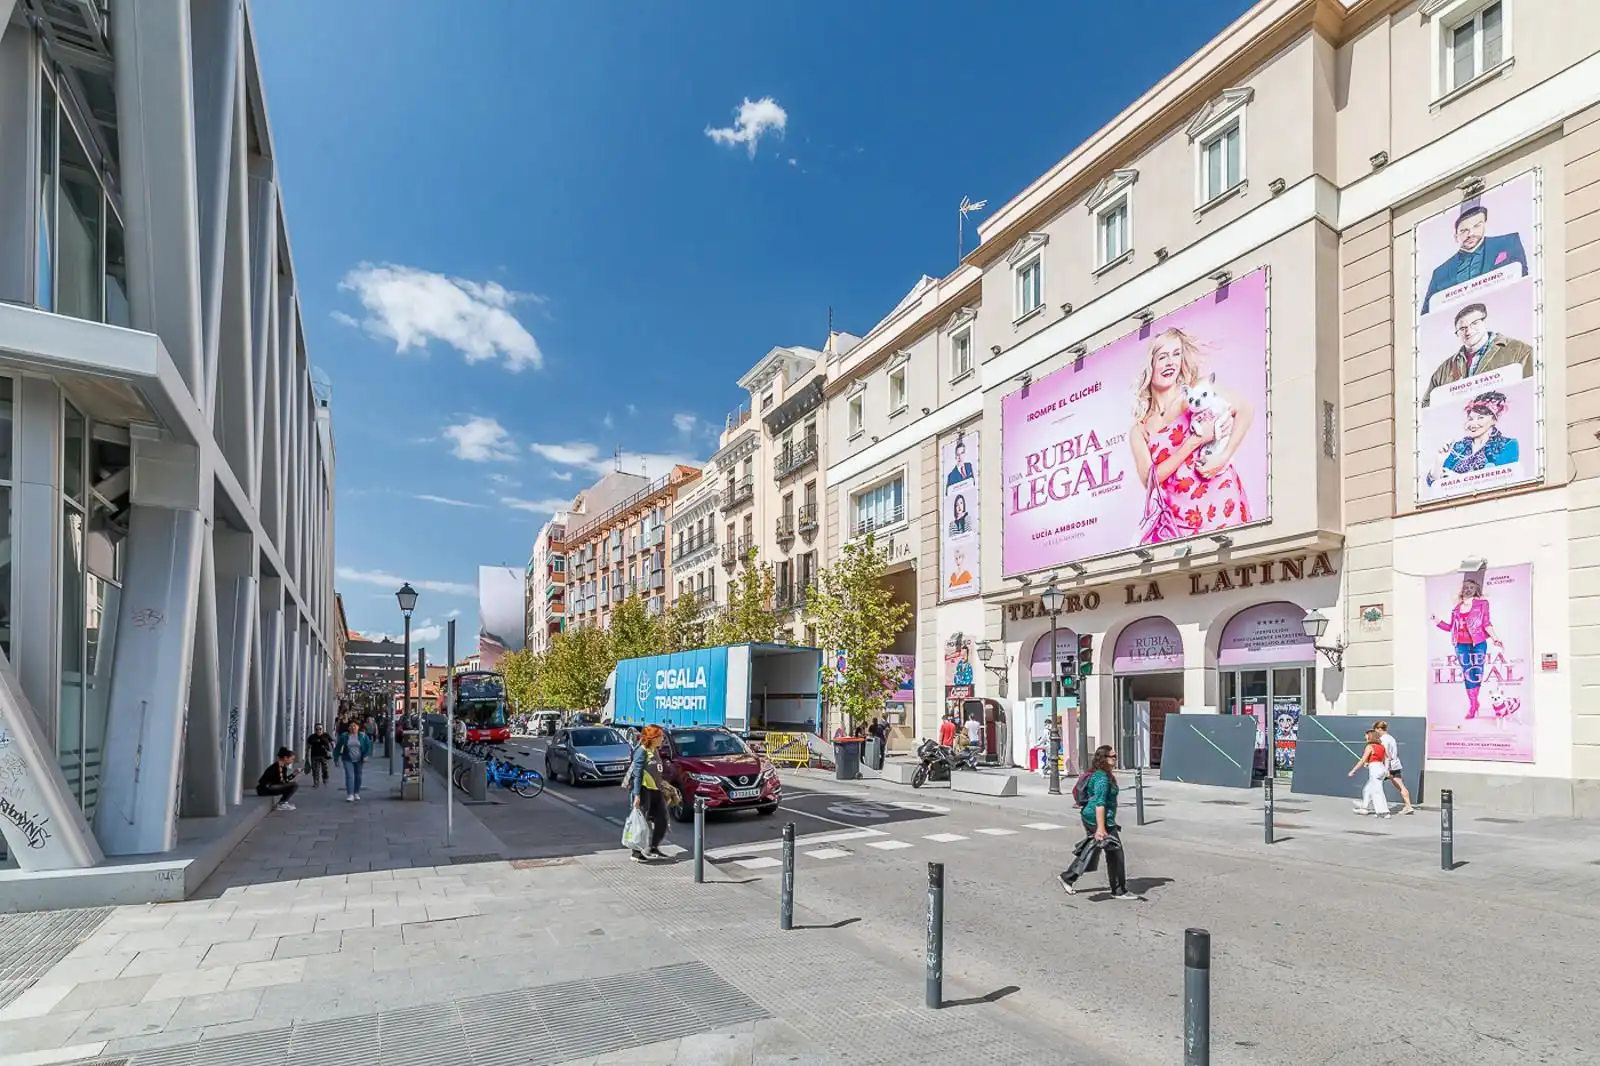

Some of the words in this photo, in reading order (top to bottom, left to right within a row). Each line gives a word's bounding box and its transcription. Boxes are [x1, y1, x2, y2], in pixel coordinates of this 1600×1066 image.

[1471, 272, 1504, 288] MERINO
[1058, 399, 1068, 409] EL
[1104, 432, 1127, 448] MUY
[1025, 429, 1103, 477] RUBIA
[1010, 451, 1125, 515] LEGAL
[1441, 479, 1461, 487] MAIA
[1464, 467, 1513, 482] CONTRERAS
[1055, 517, 1098, 535] AMBROSINI
[1008, 590, 1100, 621] TEARO
[1124, 580, 1165, 605] LA
[1188, 551, 1338, 596] LATINA
[1136, 635, 1170, 648] RUBIA
[1129, 645, 1177, 661] LEGAL
[1446, 651, 1508, 667] RUBIA
[656, 666, 707, 690] CIGALA
[1433, 665, 1524, 684] LEGAL
[655, 696, 707, 711] TRASPORTI
